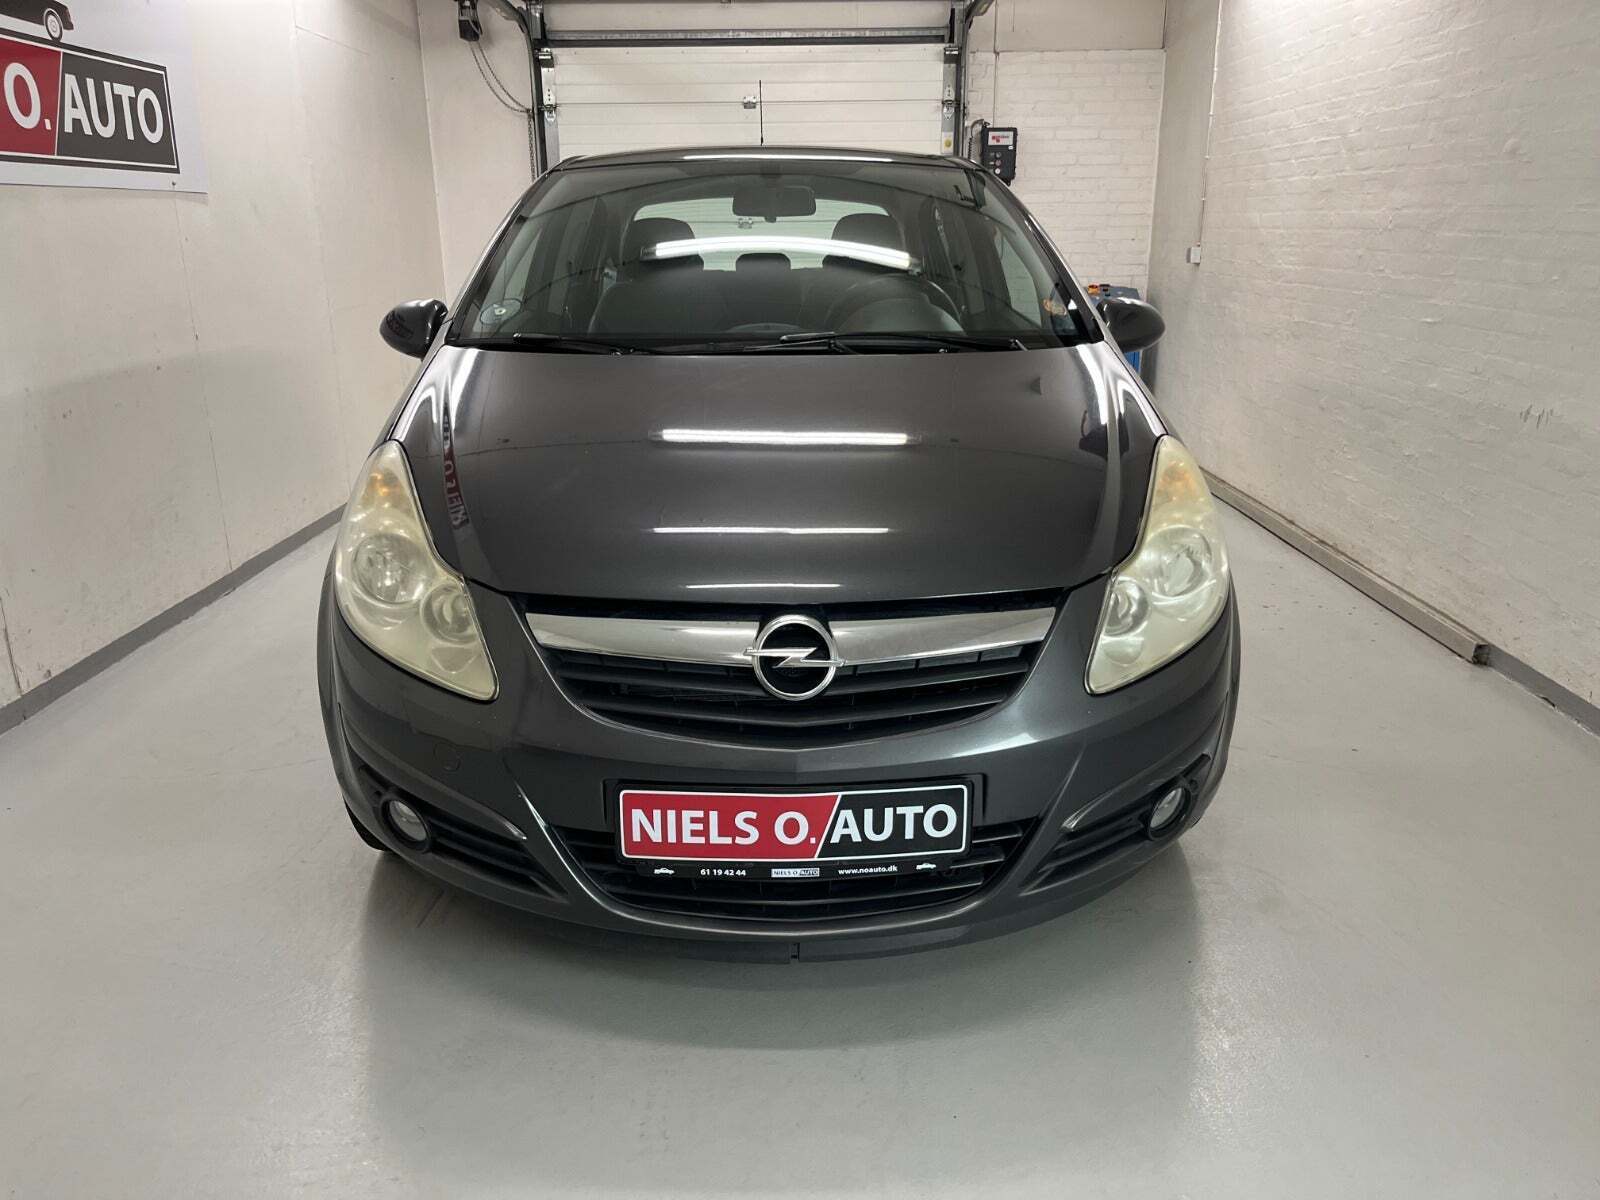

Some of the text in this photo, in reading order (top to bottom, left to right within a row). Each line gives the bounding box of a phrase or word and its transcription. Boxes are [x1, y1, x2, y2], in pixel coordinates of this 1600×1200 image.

[3, 62, 164, 144] O. AUTO
[631, 803, 958, 845] NIELS O. AUTO
[700, 868, 710, 876] 61
[713, 868, 723, 876] 19
[837, 865, 898, 875] www.noauto.dk
